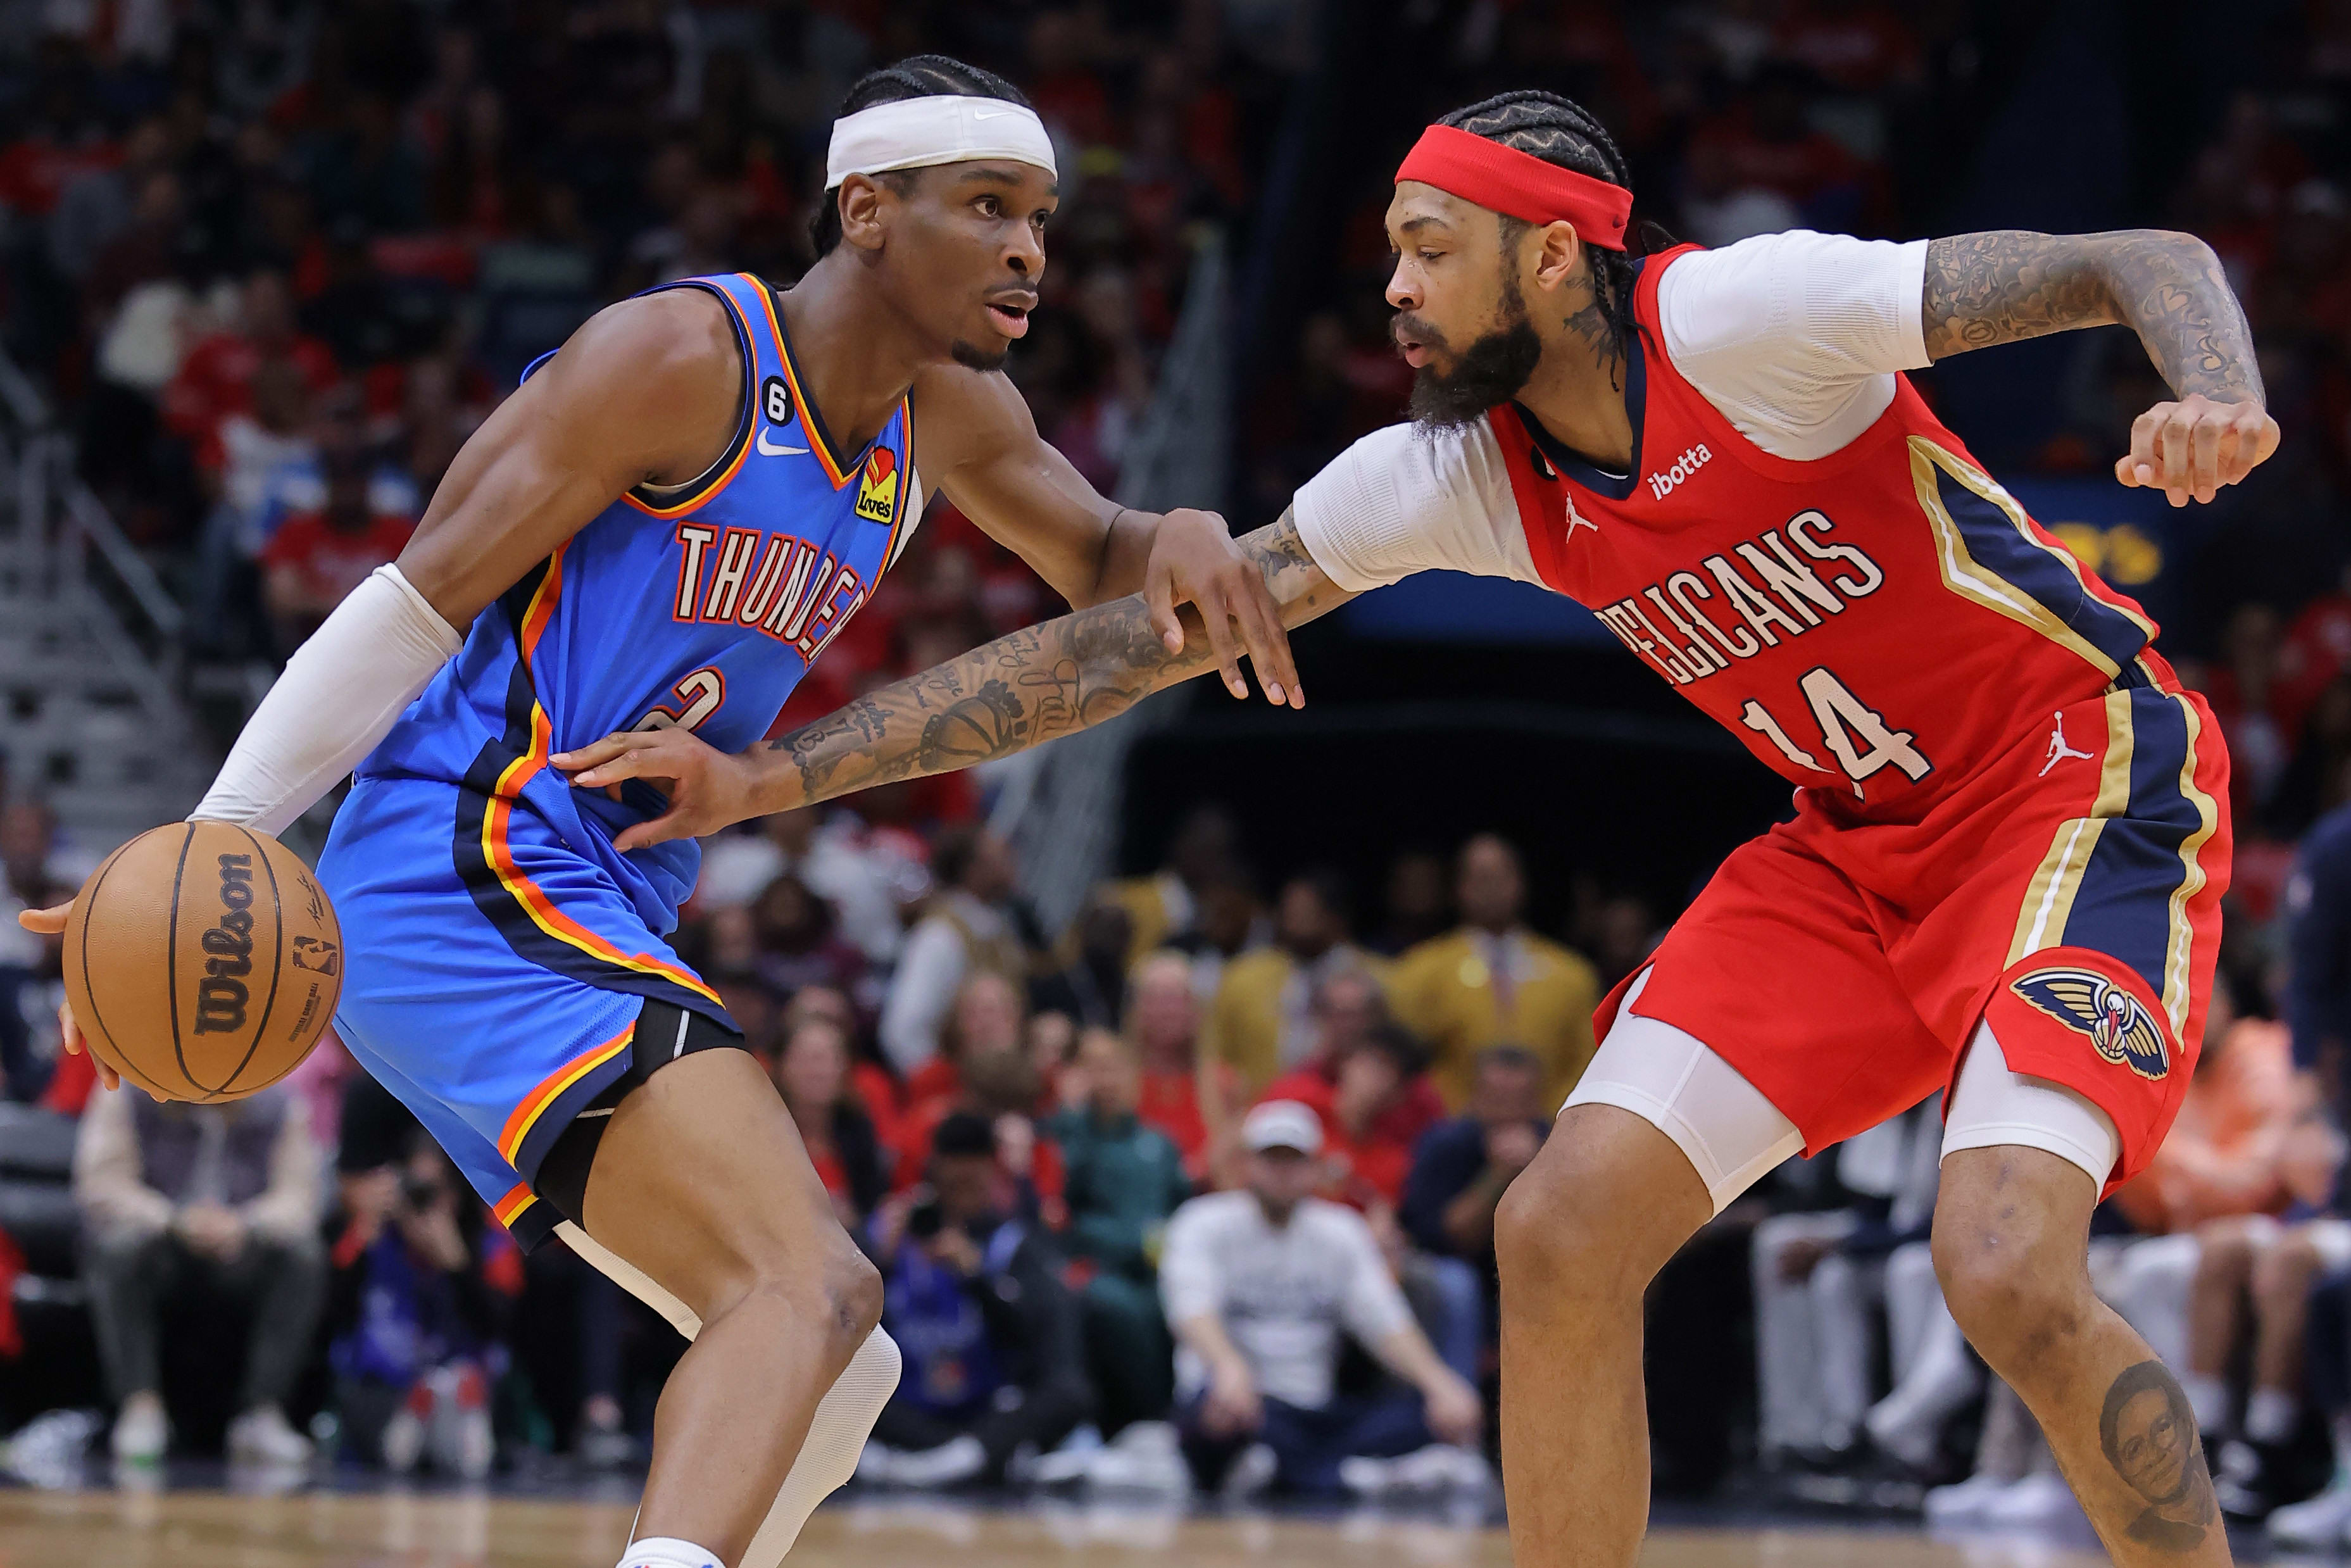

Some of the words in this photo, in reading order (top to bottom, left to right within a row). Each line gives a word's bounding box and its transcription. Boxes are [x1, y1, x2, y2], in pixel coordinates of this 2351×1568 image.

[767, 382, 787, 422] 6
[1647, 442, 1713, 501] ibotta
[675, 523, 867, 668] THUNDER
[1593, 508, 1884, 686] PELICANS
[630, 666, 725, 733] 2
[1738, 665, 1936, 805] 14
[194, 853, 254, 1036] Wilson
